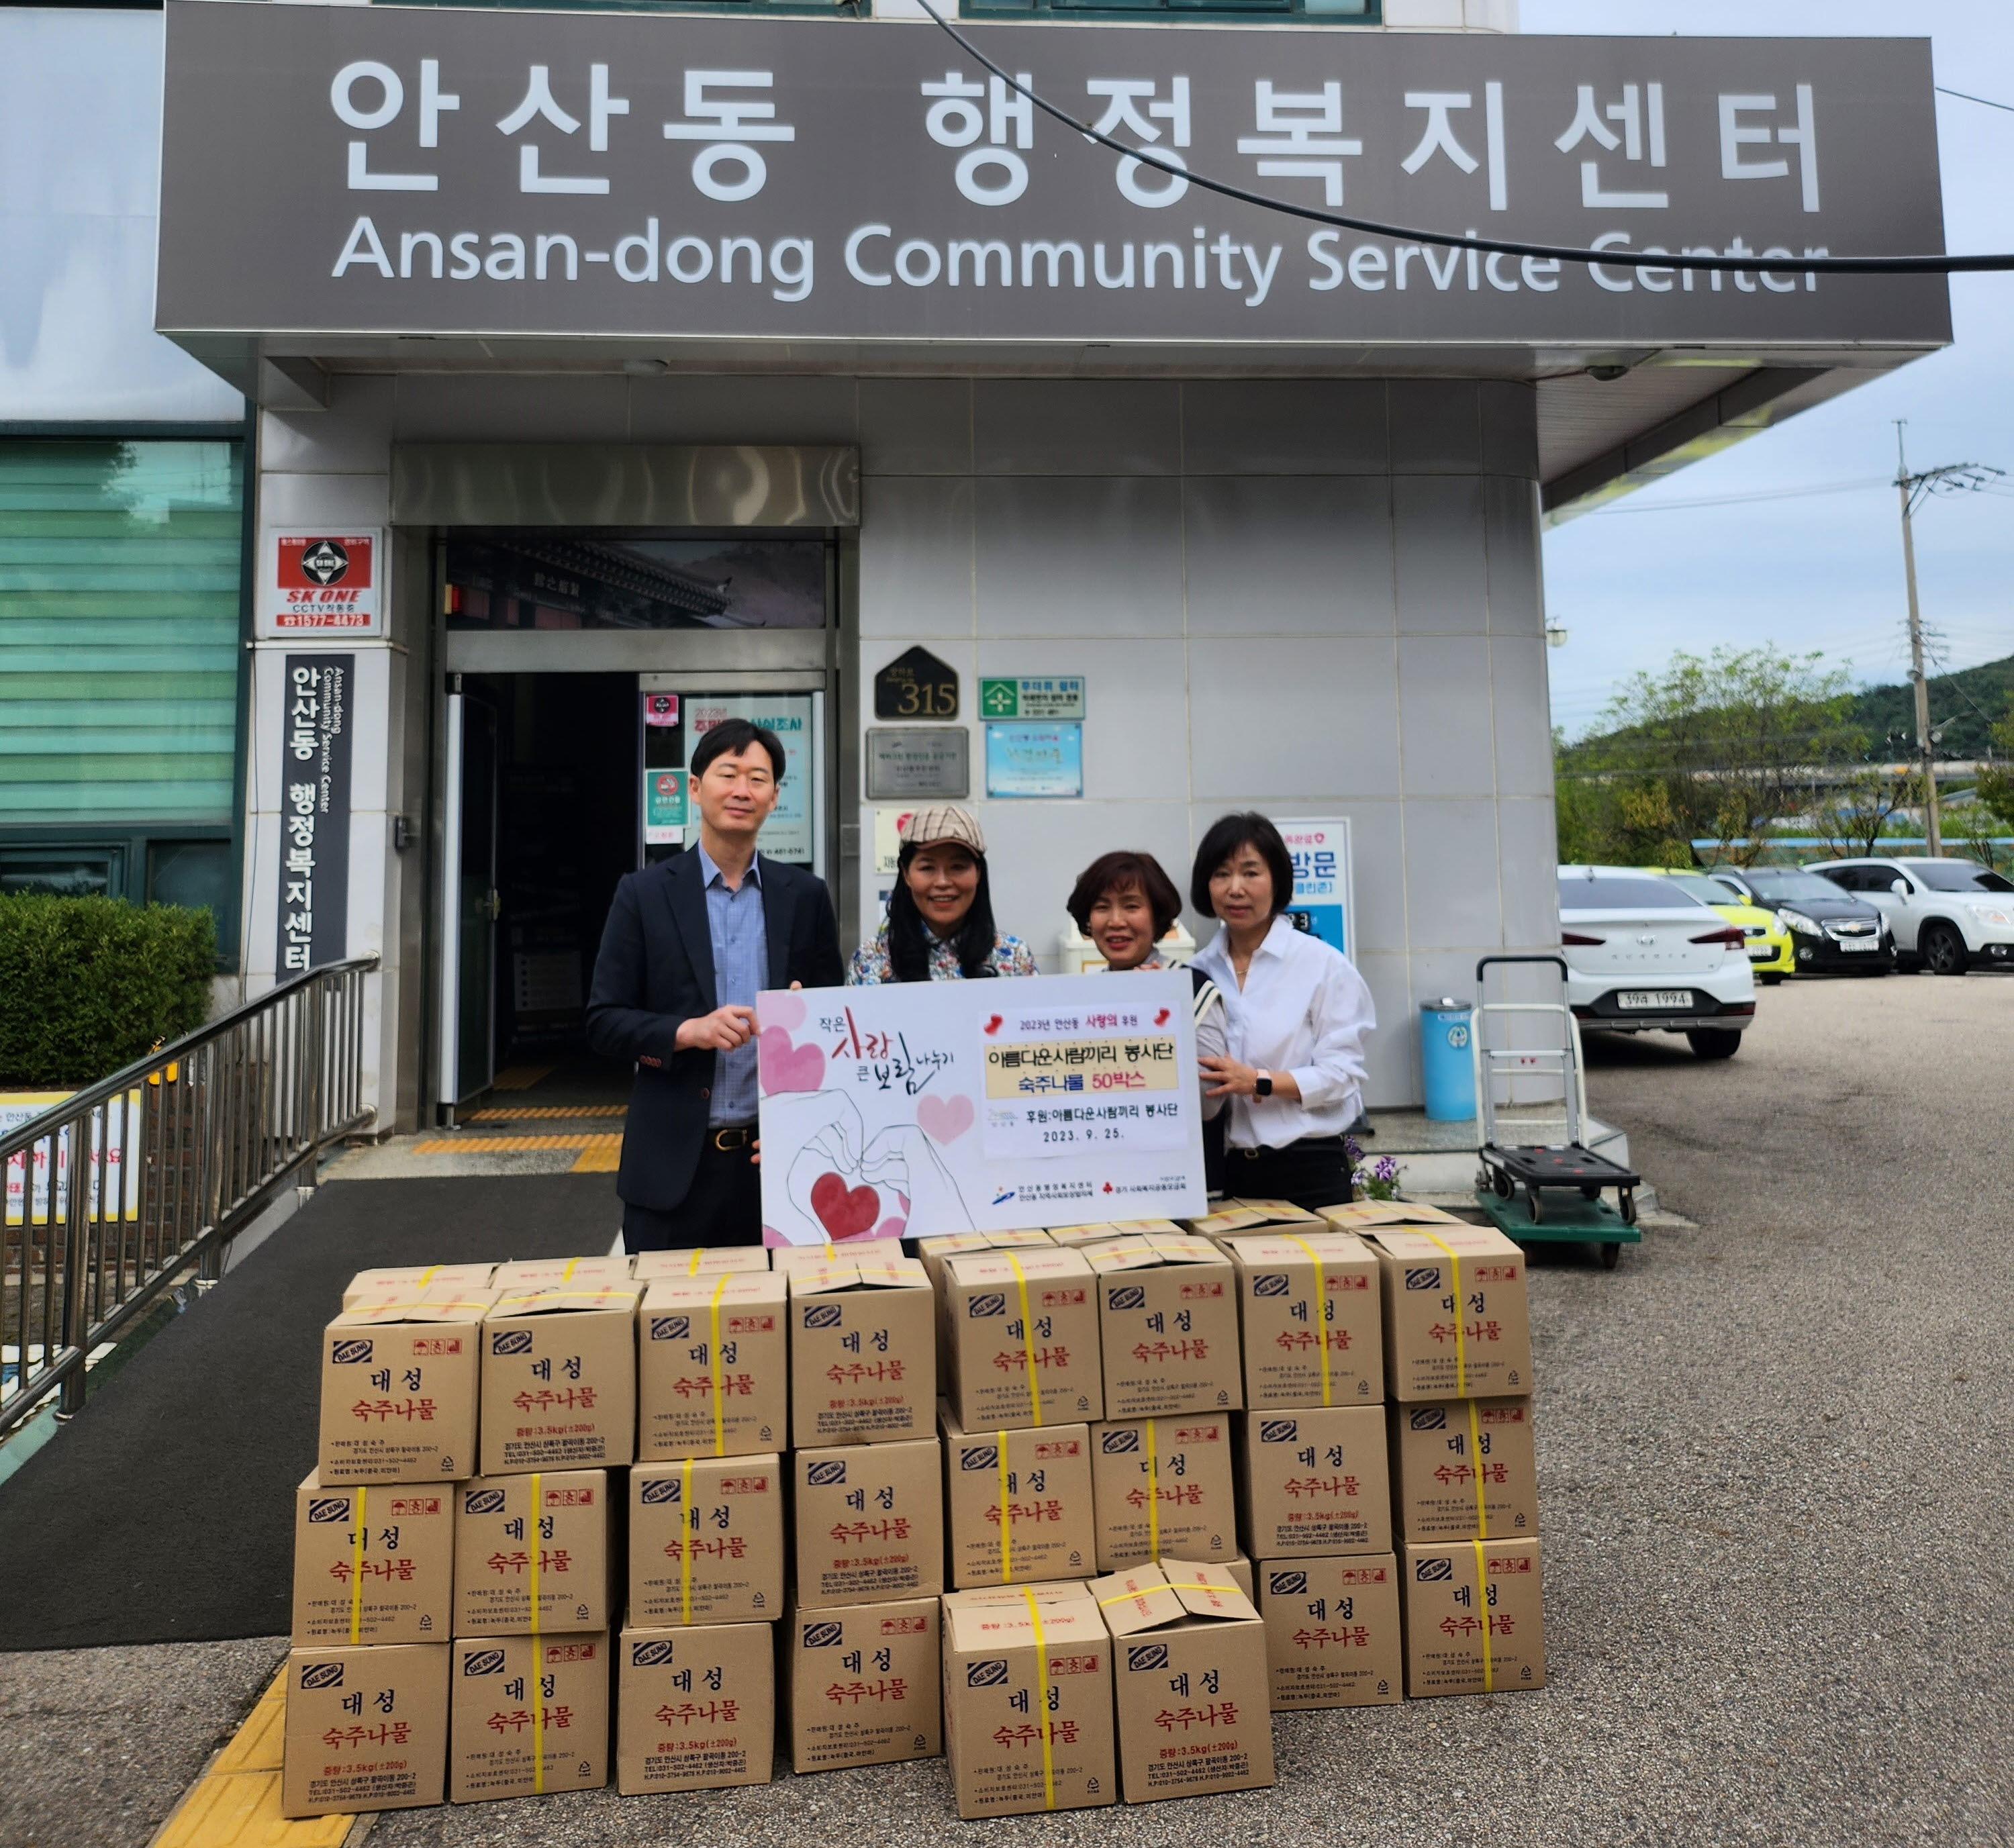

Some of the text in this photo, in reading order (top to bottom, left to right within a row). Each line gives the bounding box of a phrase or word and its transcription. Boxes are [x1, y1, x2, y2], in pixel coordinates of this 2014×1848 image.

[330, 59, 1820, 213] 안산동 행정복지센터
[332, 215, 1829, 307] Ansan-dong Community Service Center
[287, 590, 362, 603] SK ONE
[898, 683, 956, 714] 315
[284, 666, 321, 971] 안산동 행정복지센터
[820, 1016, 846, 1032] 작은
[832, 1005, 894, 1059] 사랑
[1054, 1017, 1079, 1030] 안산동
[1085, 1014, 1118, 1029] 사랑의
[857, 1065, 870, 1081] 큰
[916, 1050, 954, 1070] 나누기
[988, 1042, 1174, 1069] 아름다운사람끼리 봉사단
[1018, 1071, 1146, 1093] 숙주나물 50박스
[1145, 1102, 1178, 1118] 봉사단
[993, 1347, 1070, 1371] 숙주나물
[1131, 1339, 1208, 1363] 숙주나물
[826, 1361, 906, 1385] 숙주나물
[351, 1399, 437, 1422] 숙주나물
[513, 1387, 597, 1412] 숙주나물
[1284, 1477, 1359, 1498] 숙주나물
[984, 1500, 1063, 1525] 숙주나물
[830, 1518, 910, 1543] 숙주나물
[664, 1537, 747, 1561] 숙주나물
[1293, 1626, 1370, 1649] 숙주나물
[826, 1678, 907, 1705] 숙주나물
[655, 1700, 738, 1727] 숙주나물
[1154, 1702, 1237, 1732] 숙주나물
[322, 1722, 412, 1749] 숙주나물
[1159, 1740, 1238, 1759] 중량:3.5kg(±200g)
[1148, 1763, 1165, 1772] 경기도
[1167, 1761, 1184, 1770] 안산시
